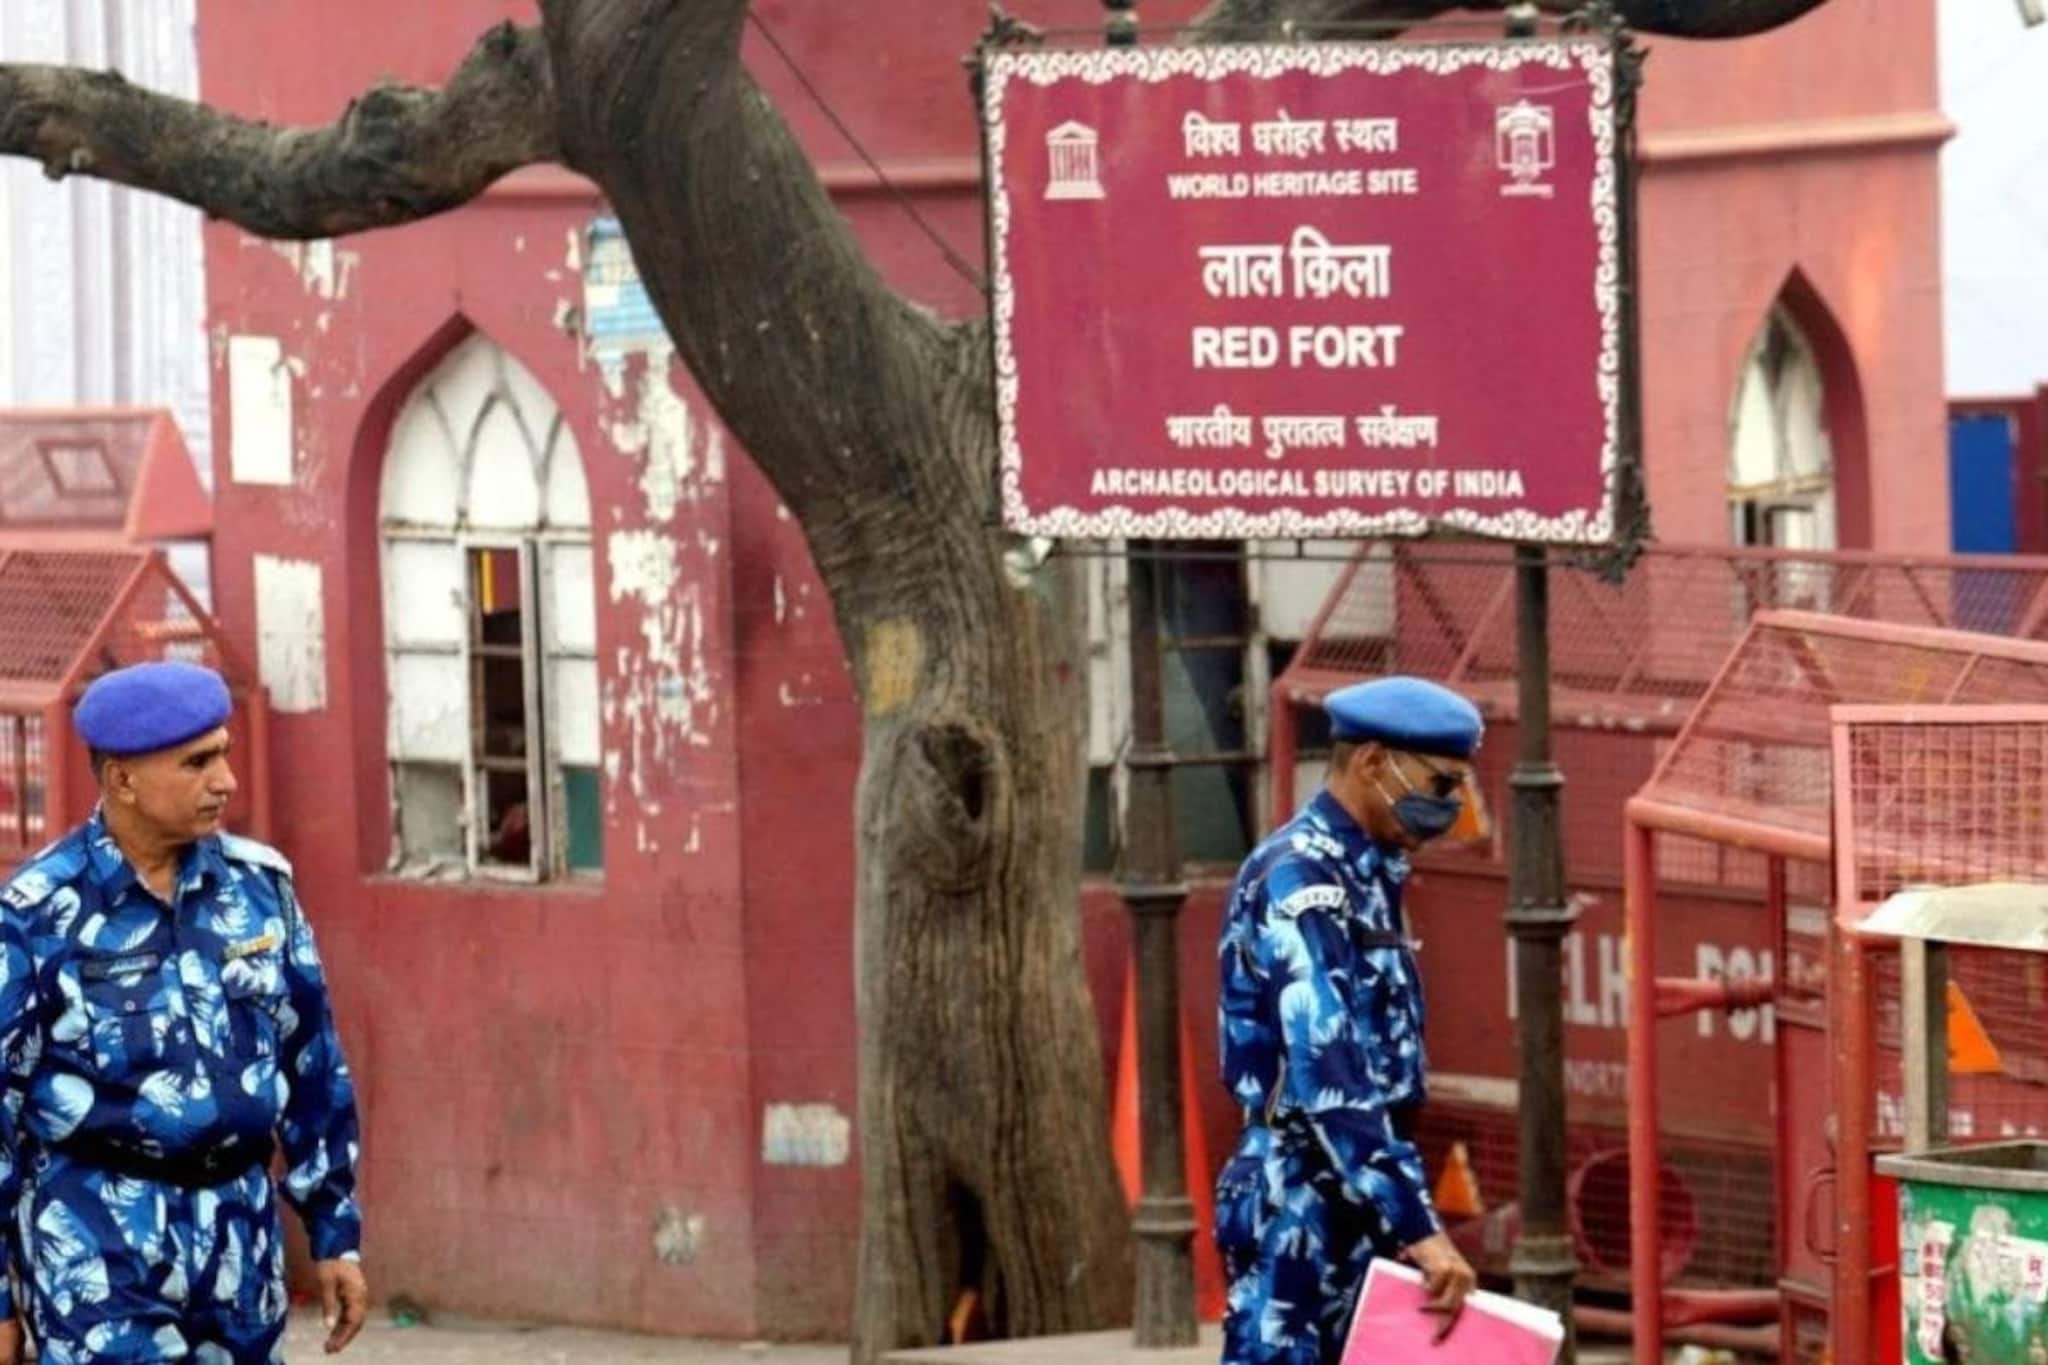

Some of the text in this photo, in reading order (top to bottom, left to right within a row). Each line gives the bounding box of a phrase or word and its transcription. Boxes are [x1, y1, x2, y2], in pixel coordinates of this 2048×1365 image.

[1182, 111, 1241, 157] विश्व
[1332, 117, 1398, 152] स्थल
[1167, 168, 1419, 199] WORLD HERITAGE SITE
[1198, 244, 1284, 298] लाल
[1191, 324, 1404, 369] RED FORT
[1165, 404, 1252, 447] भारतीय
[1355, 404, 1438, 448] सर्वेक्षण
[1090, 468, 1525, 498] ARCHAEOLOGICAL SURVEY OF INDIA
